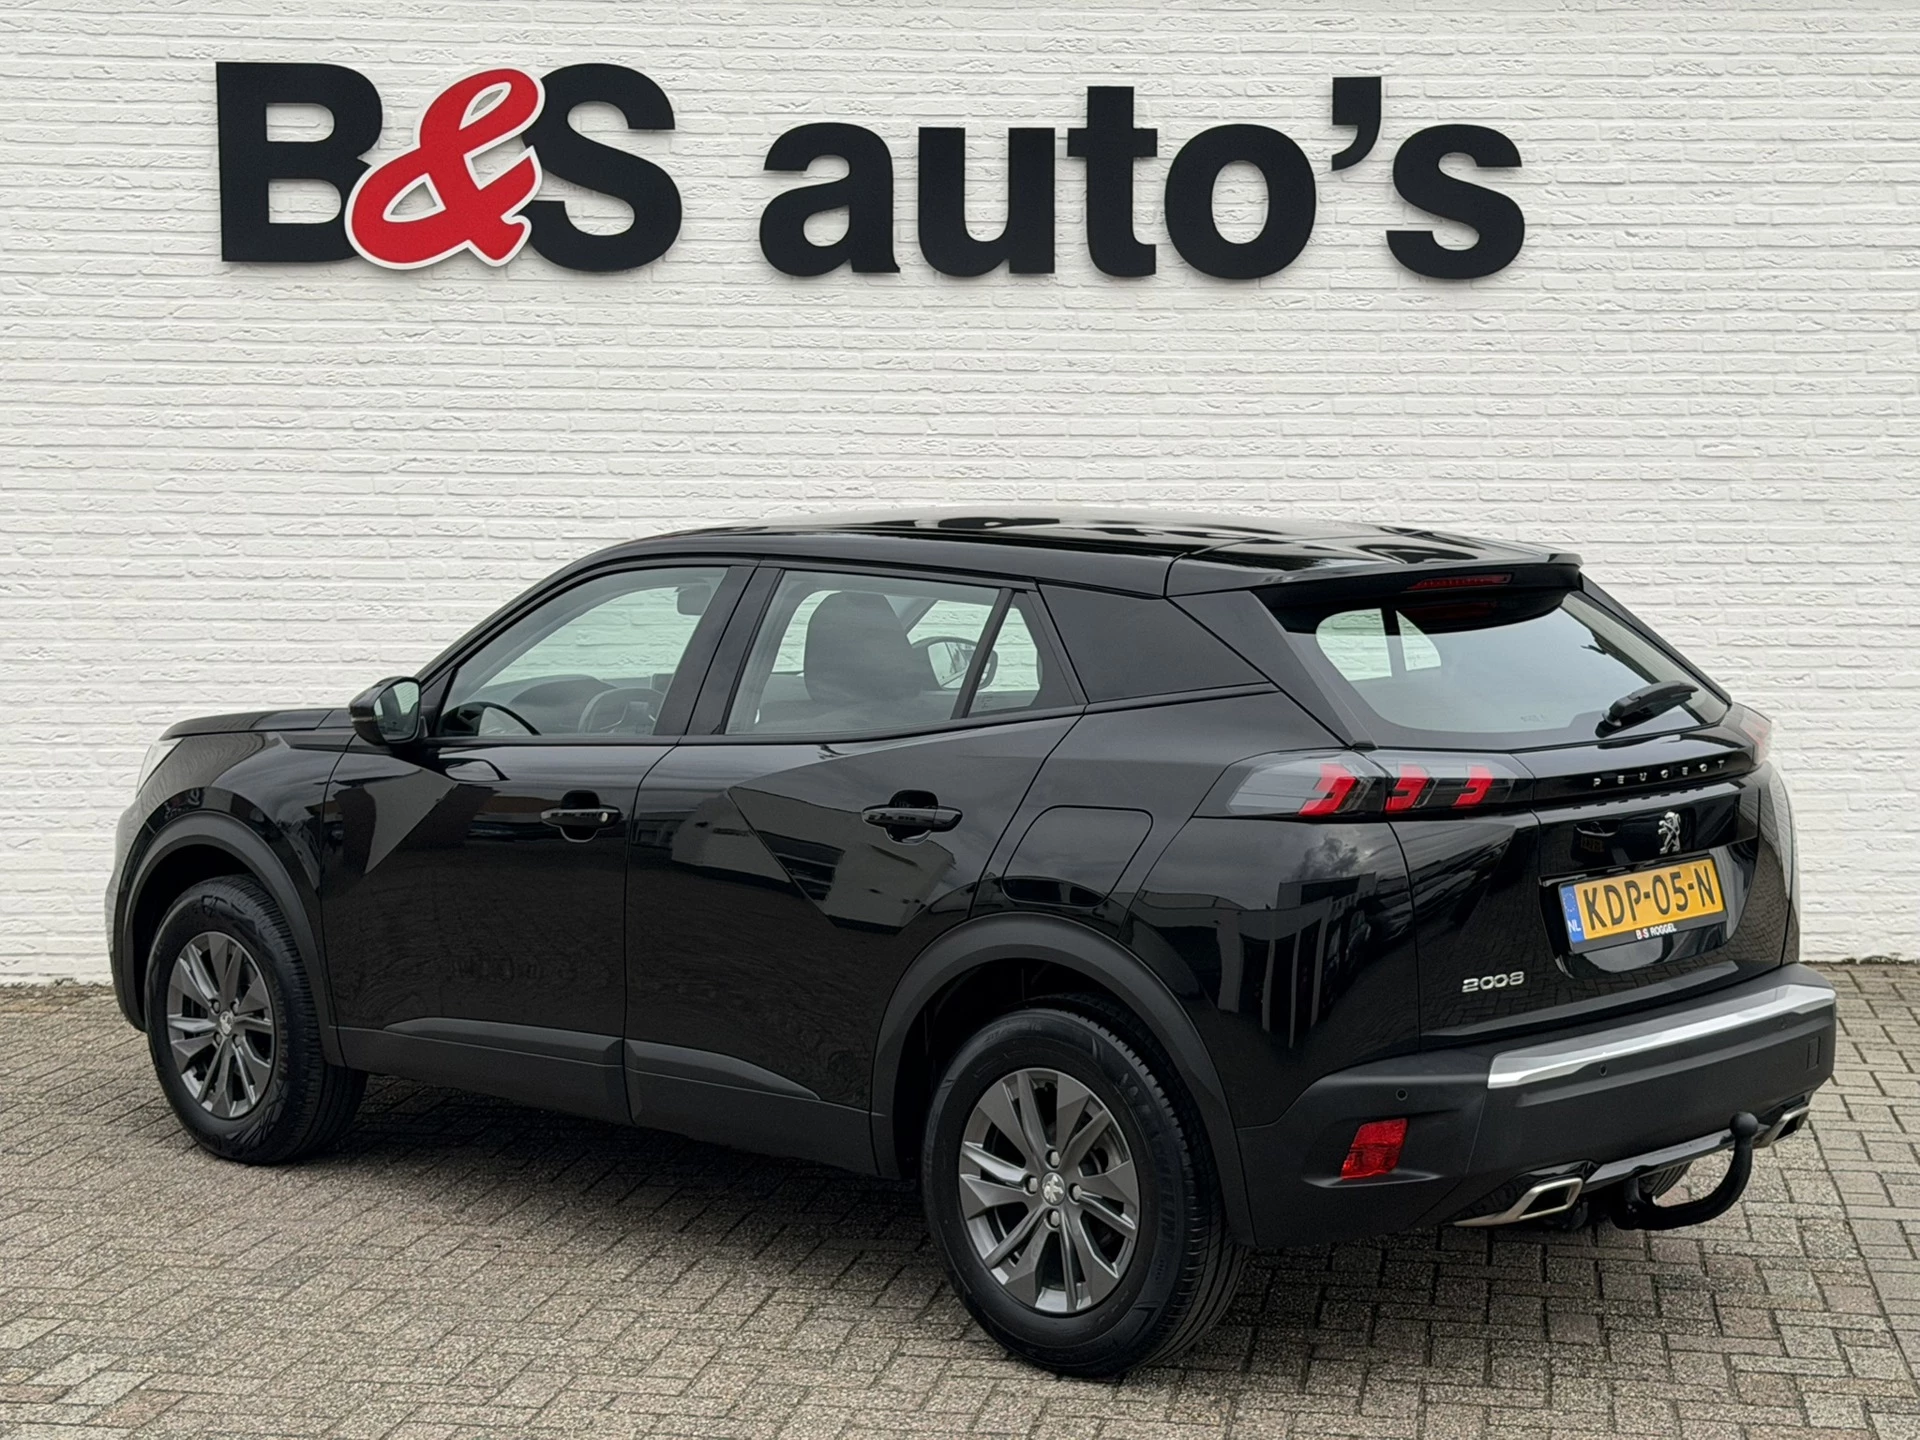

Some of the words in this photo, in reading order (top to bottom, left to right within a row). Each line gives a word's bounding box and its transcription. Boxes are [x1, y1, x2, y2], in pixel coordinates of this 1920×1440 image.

[216, 62, 682, 273] B&S
[760, 77, 1526, 282] auto's
[1593, 760, 1725, 787] PEUGEOT
[1583, 866, 1716, 931] KDP-05-N
[1568, 921, 1581, 932] NL
[1650, 923, 1677, 937] ROGGEL
[1461, 971, 1524, 992] 2008
